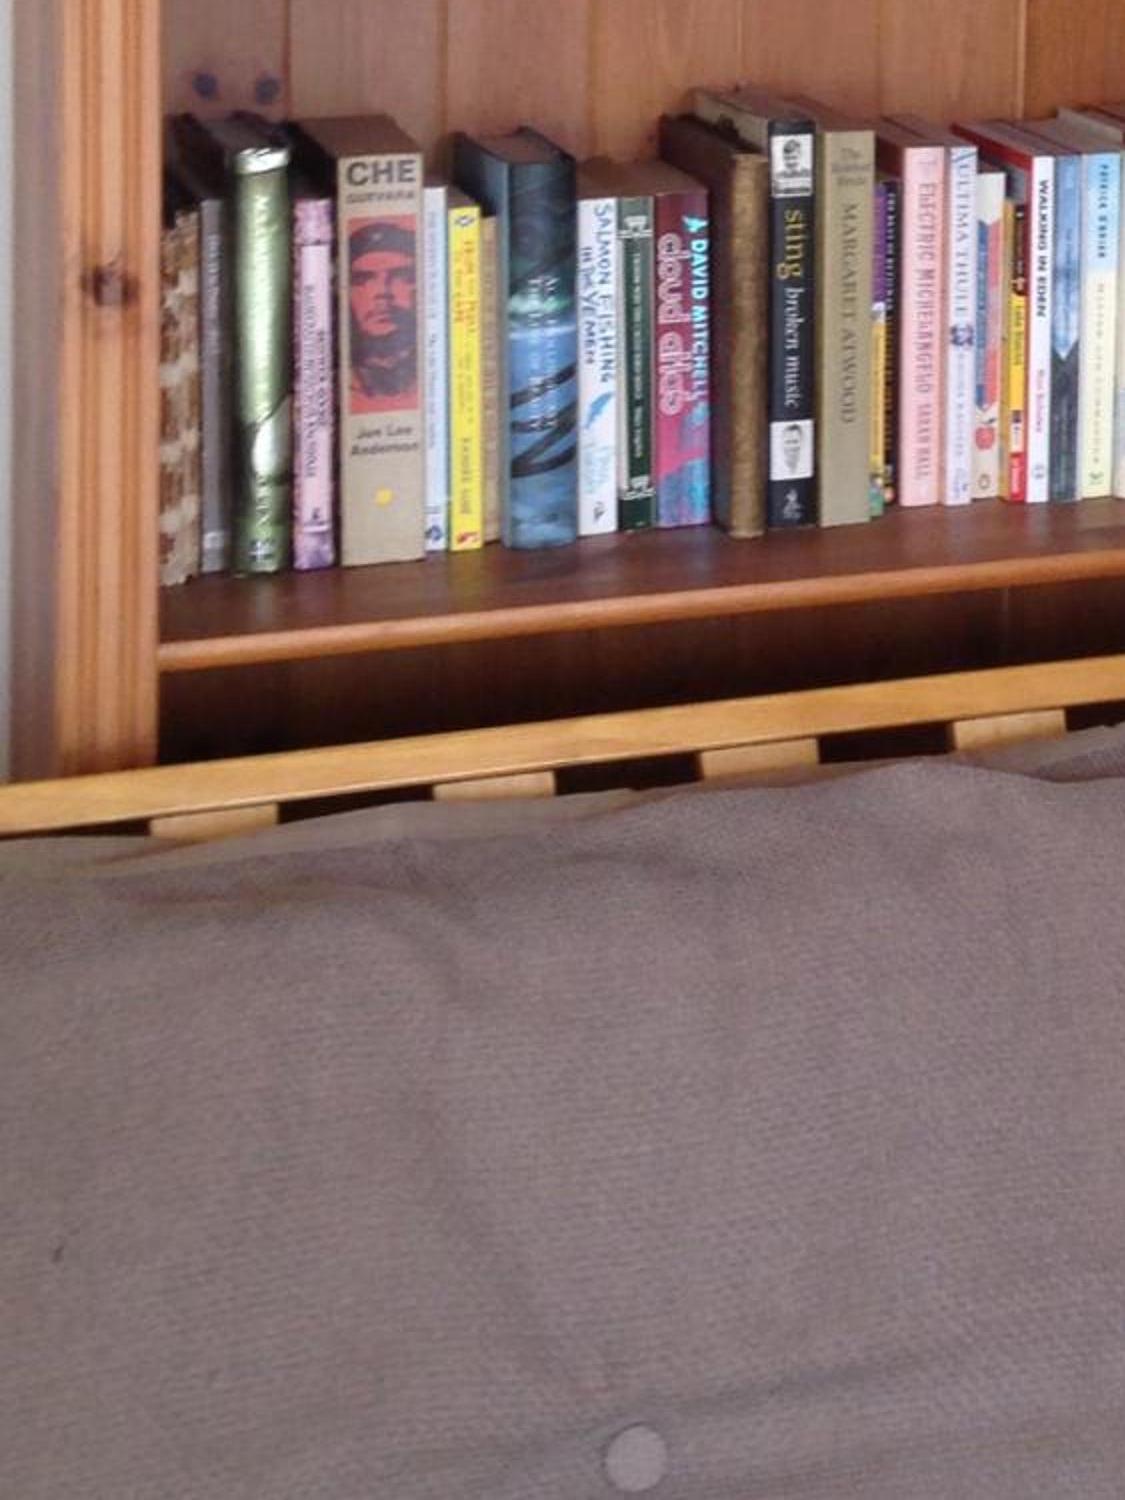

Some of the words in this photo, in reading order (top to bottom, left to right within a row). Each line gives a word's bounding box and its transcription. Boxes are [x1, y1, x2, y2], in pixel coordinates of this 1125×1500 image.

[346, 159, 417, 187] CHE
[954, 163, 970, 244] ULTIMA
[1096, 163, 1109, 210] PATRICK
[594, 203, 617, 286] SALMON
[776, 208, 808, 279] sting
[916, 182, 936, 261] ELECTRIC
[1036, 178, 1050, 250] WALKING
[657, 232, 692, 324] cloud
[692, 238, 708, 299] DAVID
[839, 201, 857, 320] MARGARET
[954, 249, 970, 318] THULE
[1035, 276, 1049, 318] EDEN
[1036, 255, 1049, 272] IN
[580, 292, 599, 365] YEMEN
[599, 294, 617, 383] FISHING
[691, 304, 709, 399] MITCHELL
[785, 286, 807, 350] broken
[914, 267, 936, 394] MICHELANGELO
[658, 330, 692, 415] atlas
[784, 354, 802, 409] music
[840, 327, 857, 423] ATWOOD
